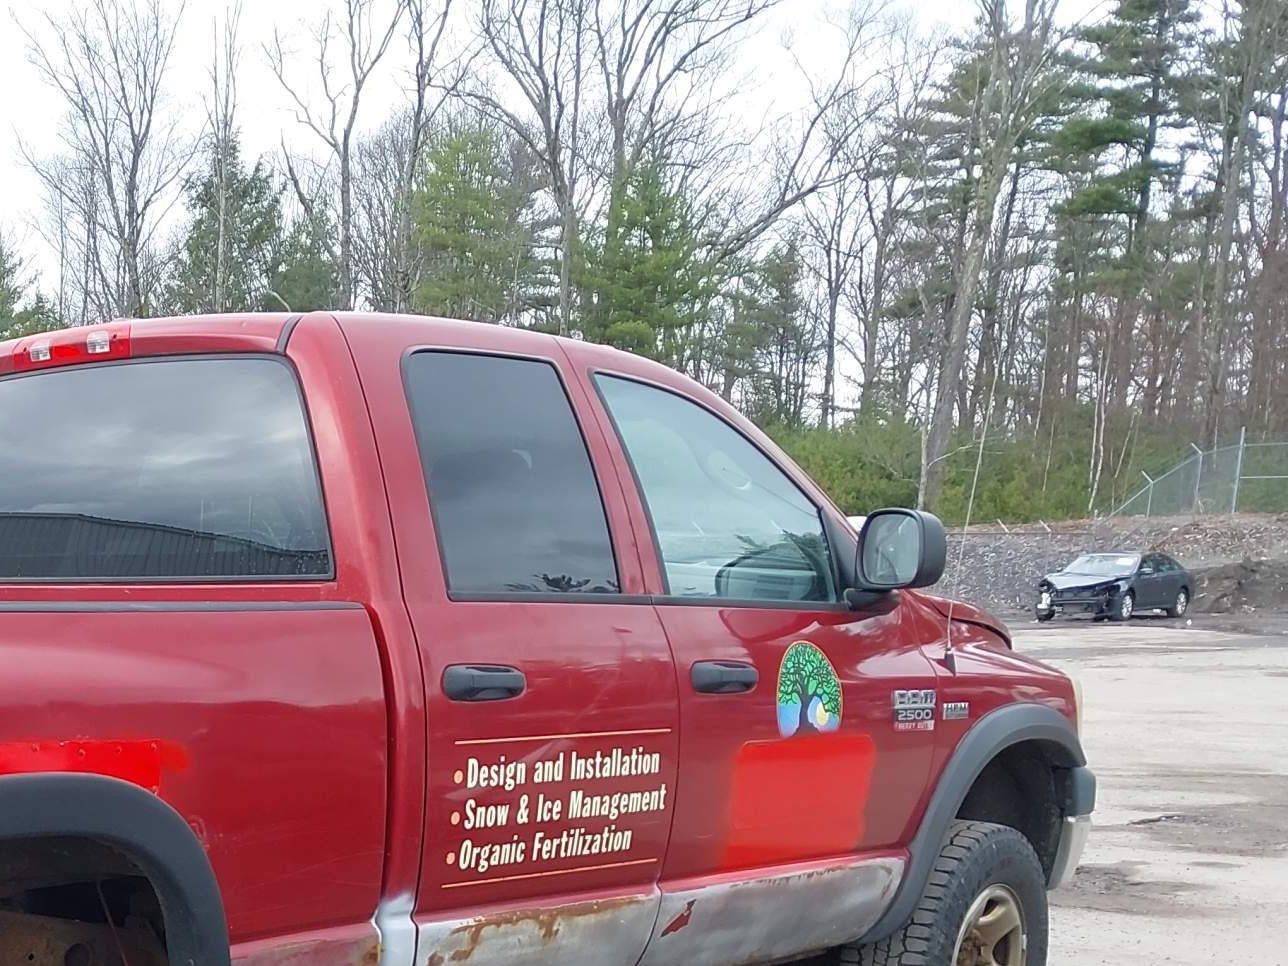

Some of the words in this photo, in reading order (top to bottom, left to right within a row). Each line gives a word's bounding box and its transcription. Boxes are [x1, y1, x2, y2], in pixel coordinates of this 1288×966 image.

[898, 709, 932, 720] 2500
[467, 756, 526, 791] Design
[534, 752, 564, 783] and
[570, 747, 660, 780] Installation
[464, 799, 510, 829] Snow
[516, 794, 529, 824] &
[536, 794, 562, 822] Ice
[568, 784, 666, 820] Management
[459, 835, 526, 872] Organic
[532, 825, 632, 861] Fertilization
